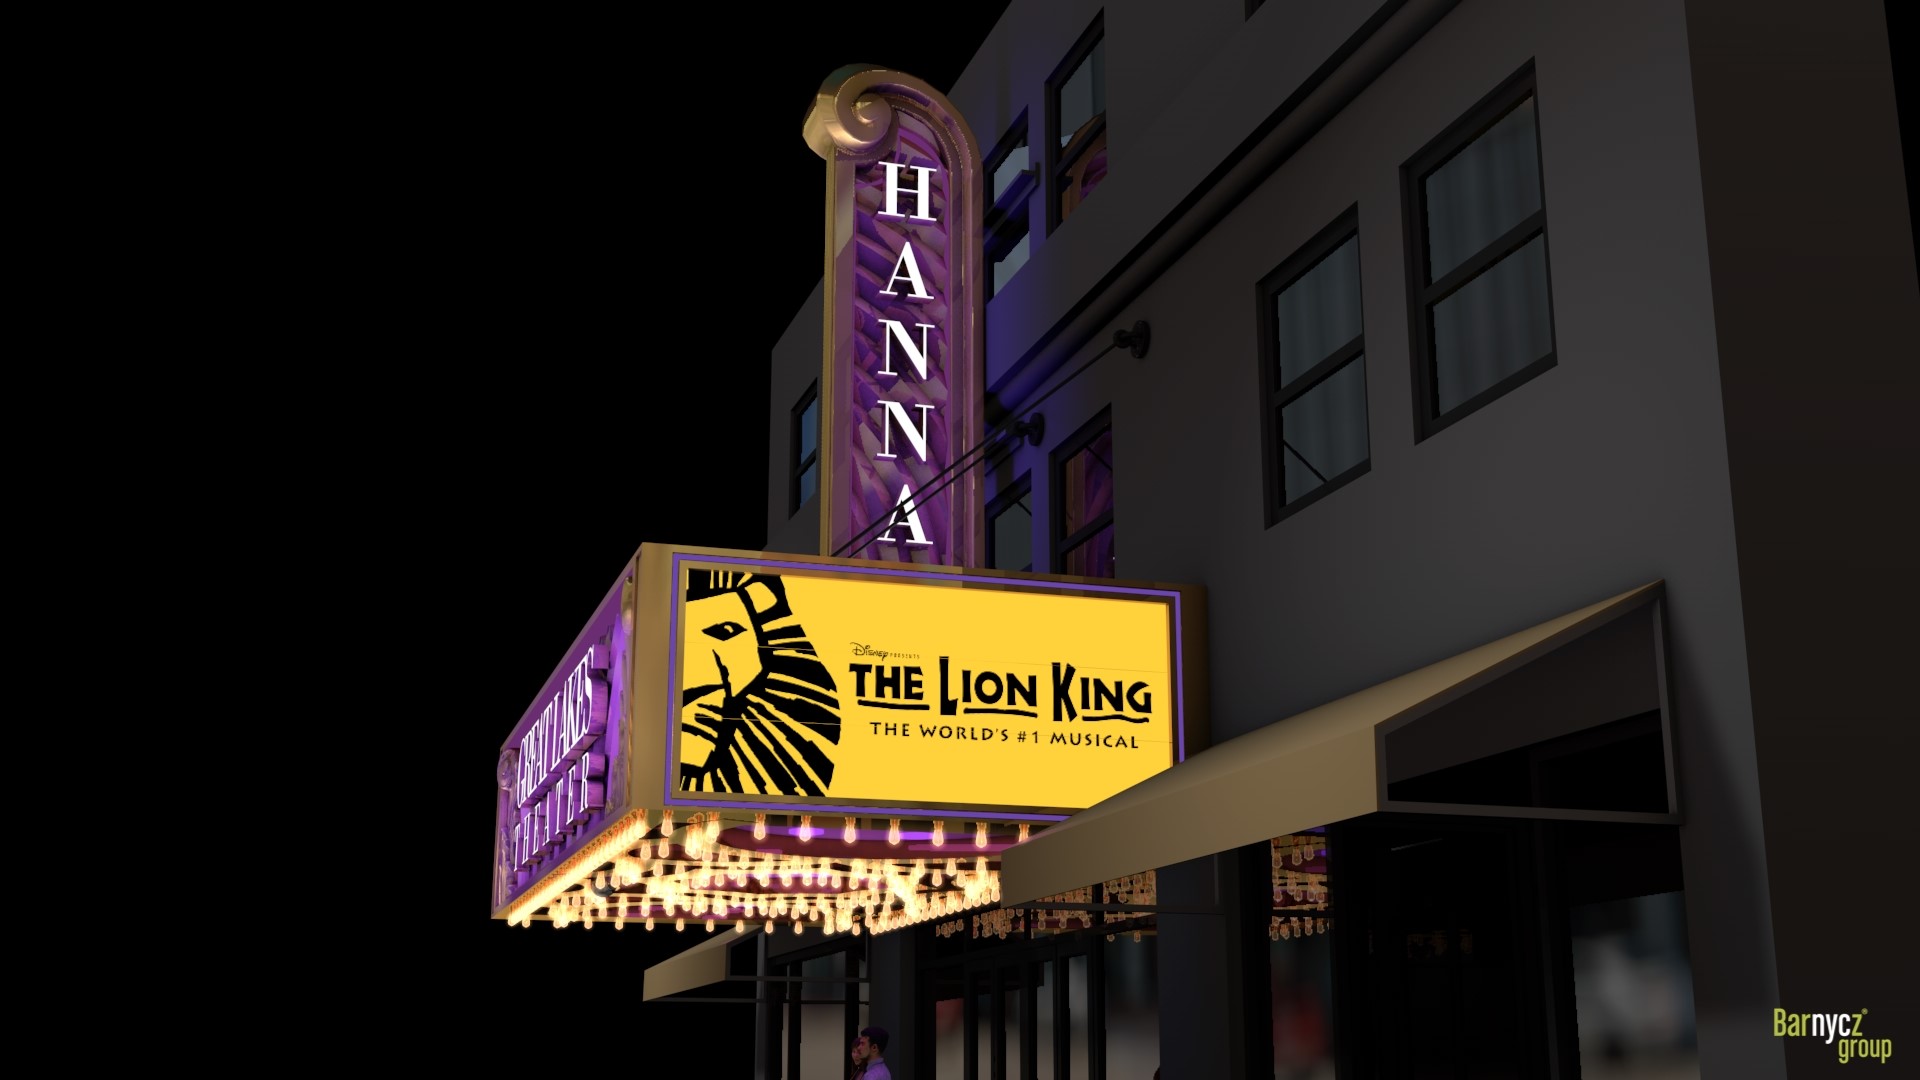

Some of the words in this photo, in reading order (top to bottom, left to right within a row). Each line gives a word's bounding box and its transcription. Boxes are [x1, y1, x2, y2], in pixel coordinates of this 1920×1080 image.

[877, 161, 937, 546] HANNA
[516, 701, 553, 809] GREAT
[550, 644, 595, 771] LAKES
[849, 663, 924, 700] THE
[939, 656, 1037, 716] LION
[1051, 662, 1152, 722] KING
[870, 722, 910, 737] THE
[919, 724, 1009, 742] WORLD'S
[1017, 731, 1039, 744] #1
[1050, 732, 1139, 749] MUSICAL
[513, 752, 590, 872] THEATER
